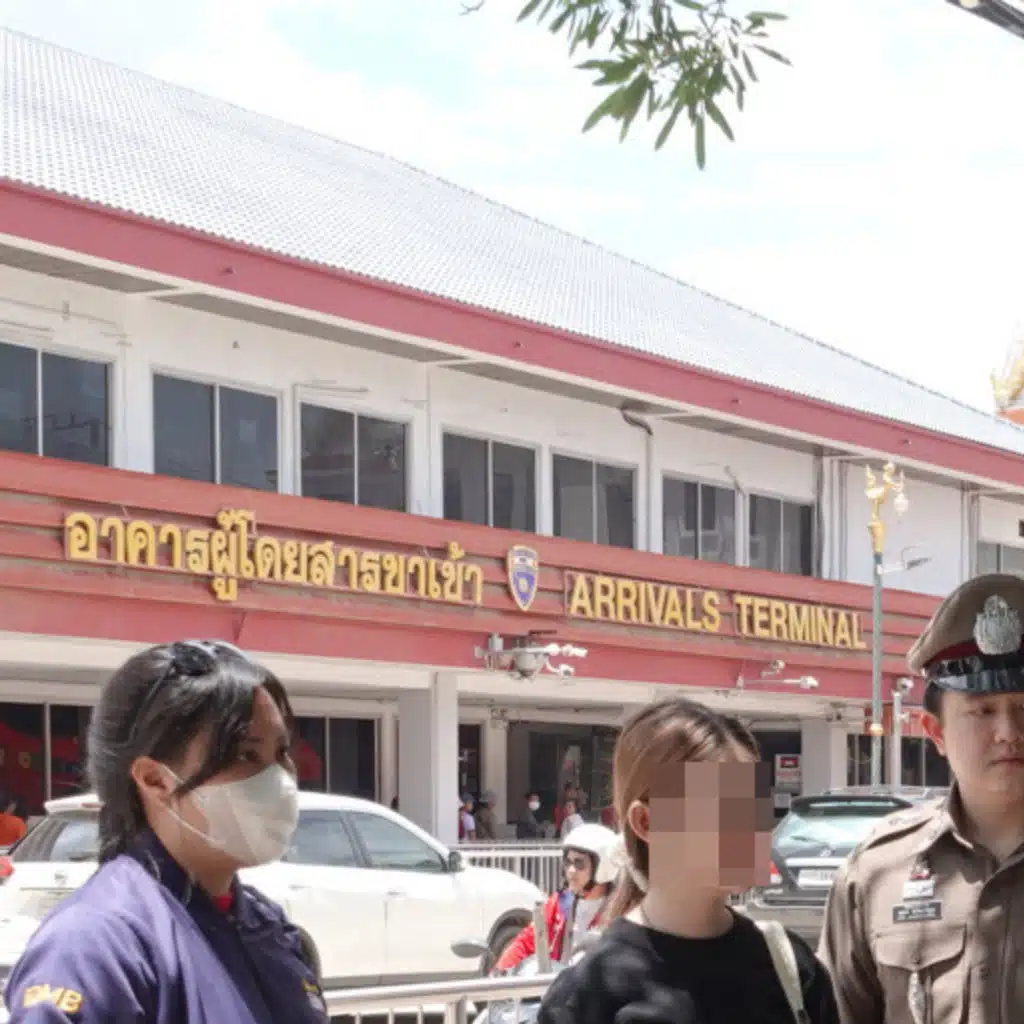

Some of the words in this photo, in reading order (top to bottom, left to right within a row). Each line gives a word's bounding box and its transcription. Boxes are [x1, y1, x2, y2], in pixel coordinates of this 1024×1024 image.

[65, 508, 484, 604] อาคารผู้โดยสารขาเข้า
[569, 573, 722, 633] ARRIVALS
[732, 594, 867, 650] TERMINAL
